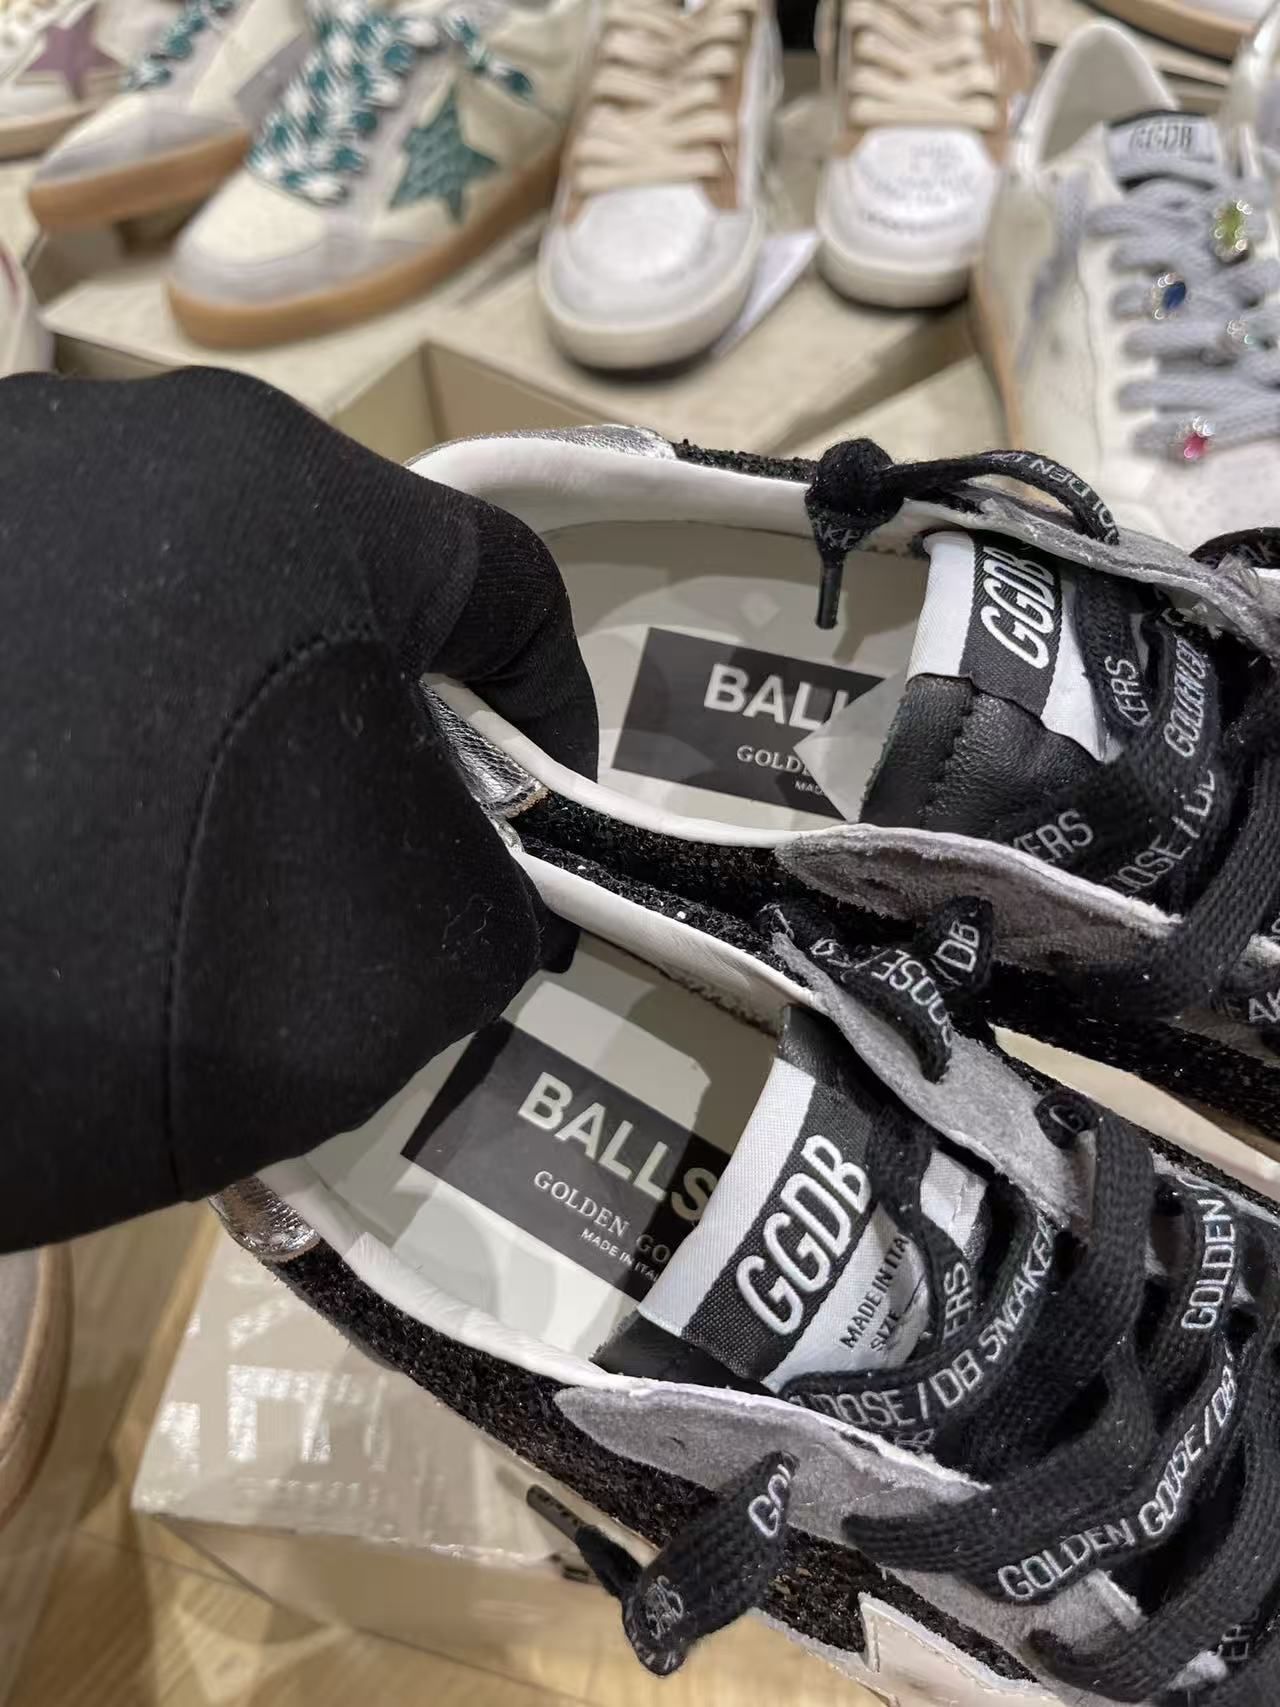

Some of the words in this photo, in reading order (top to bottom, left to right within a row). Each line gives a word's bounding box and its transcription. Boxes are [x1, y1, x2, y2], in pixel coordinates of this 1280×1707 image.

[980, 546, 1056, 669] GGDB
[518, 1071, 718, 1222] BALLS
[534, 1170, 630, 1237] GOLDEN
[636, 1234, 671, 1263] GO
[581, 1228, 619, 1257] MADE
[619, 1251, 635, 1266] IN
[736, 1134, 872, 1336] GGDB
[1181, 1199, 1236, 1329] GOLDEN
[840, 1291, 881, 1348] MADE
[872, 1267, 893, 1294] IN
[884, 1238, 909, 1269] ITA
[870, 1309, 898, 1352] SIZE
[943, 1262, 972, 1338] ERS
[978, 1213, 1058, 1362] SNEAKER
[998, 1519, 1136, 1599] GOLDEN
